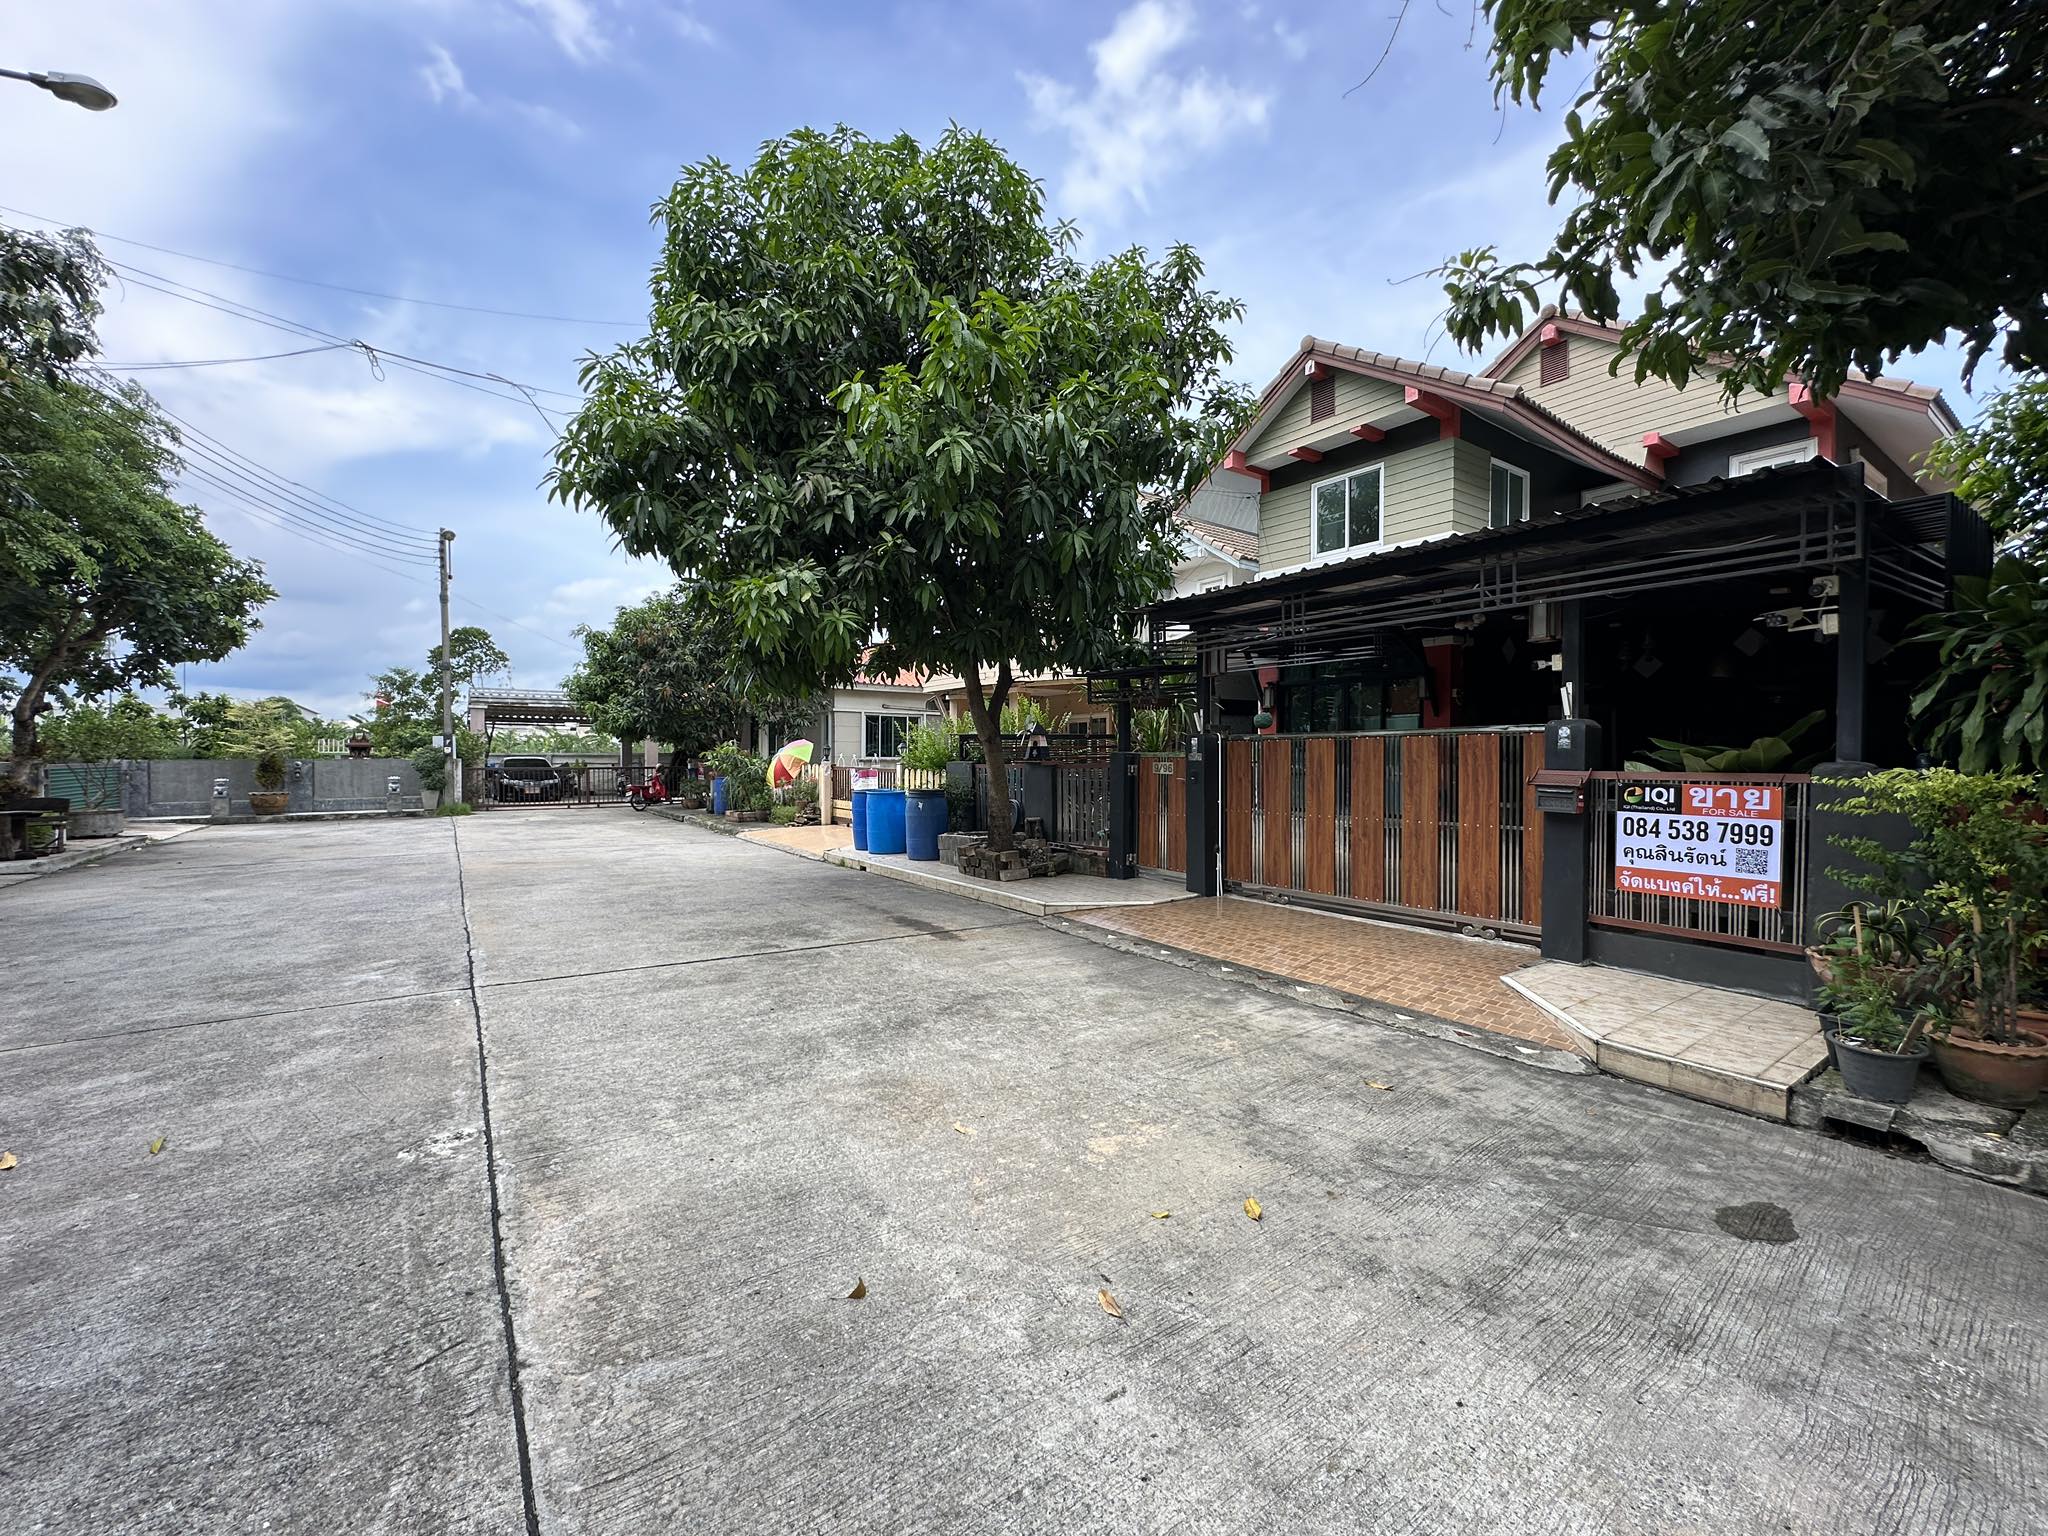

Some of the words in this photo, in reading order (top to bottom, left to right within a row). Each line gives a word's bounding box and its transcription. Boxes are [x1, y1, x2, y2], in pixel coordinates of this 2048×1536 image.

[1154, 763, 1173, 772] 9/96
[1644, 787, 1675, 804] IQI
[1689, 787, 1771, 811] ขาย
[1702, 808, 1726, 817] FOR
[1728, 809, 1759, 818] SALE
[1623, 816, 1661, 838] 084
[1668, 819, 1709, 842] 538
[1717, 822, 1774, 847] 7999
[1623, 843, 1728, 867] คุณสินรัตน์
